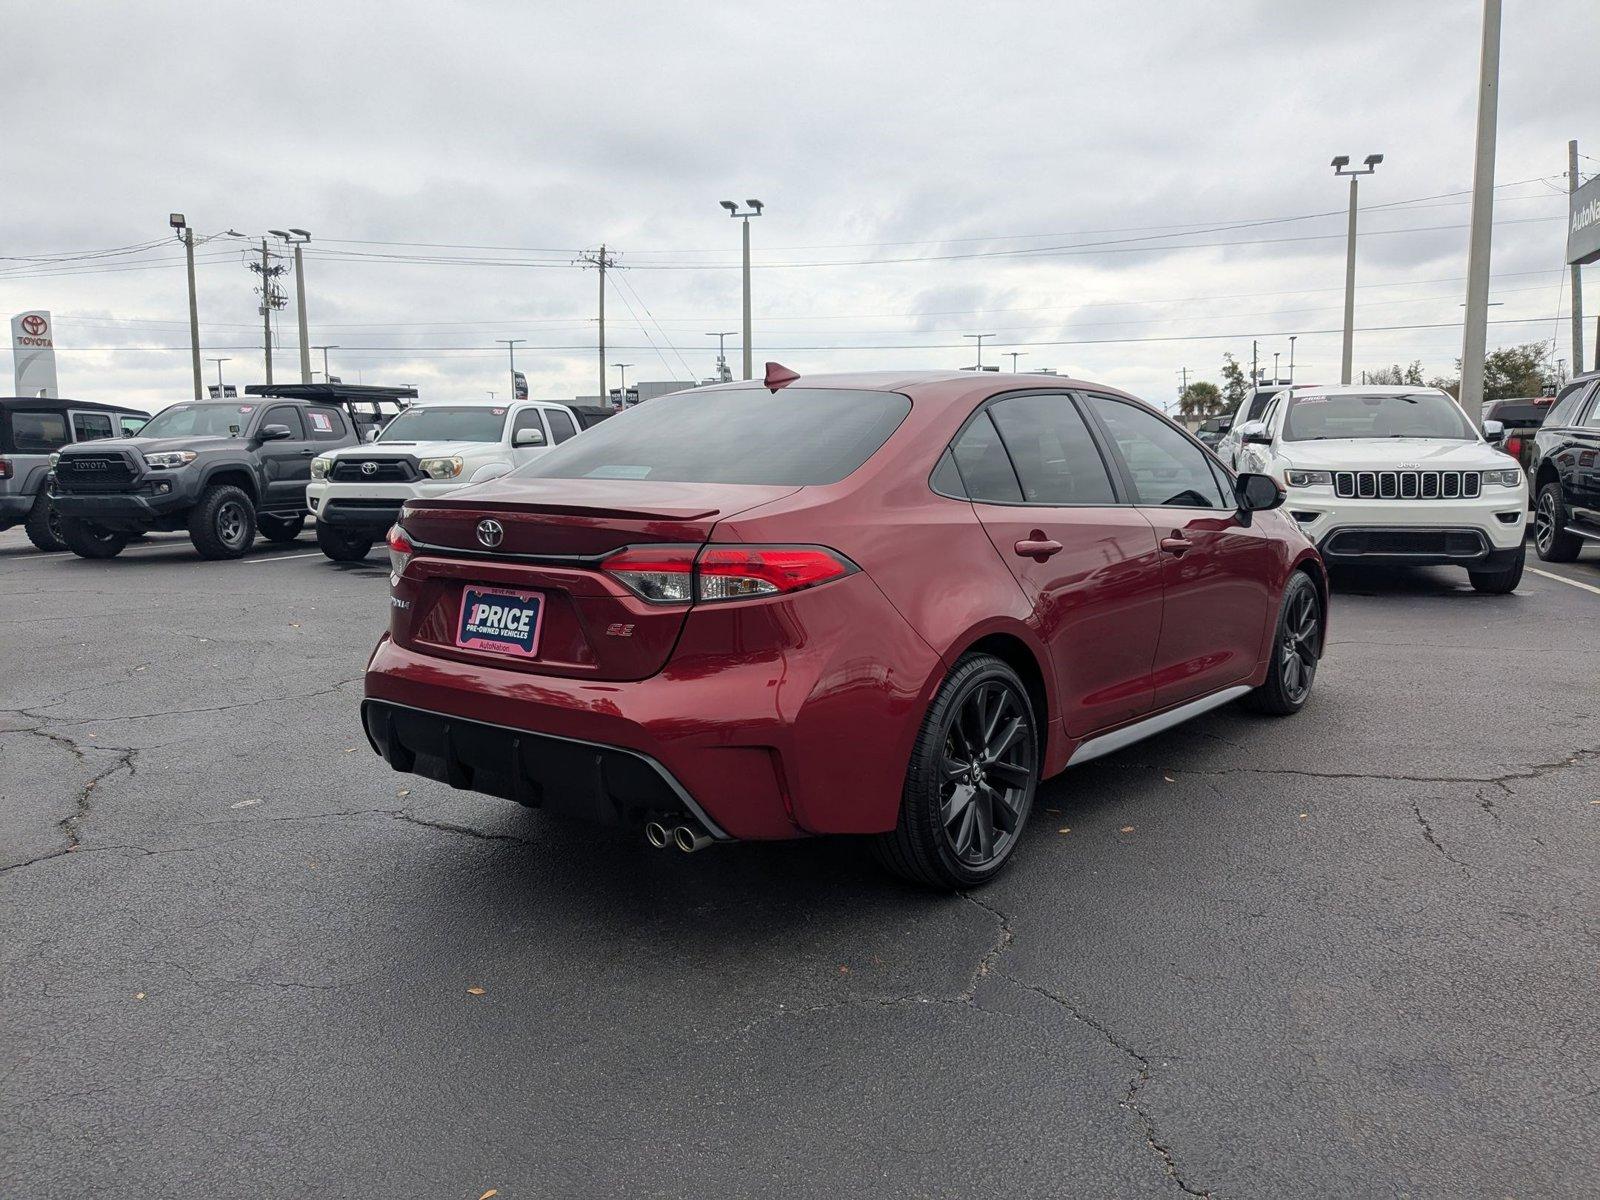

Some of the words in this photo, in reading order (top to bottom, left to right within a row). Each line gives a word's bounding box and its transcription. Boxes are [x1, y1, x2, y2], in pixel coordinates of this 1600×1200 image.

[16, 336, 53, 347] TOYOTA
[1396, 461, 1422, 469] Jeep
[466, 624, 500, 635] PRE-OWNED
[500, 628, 529, 640] VEHICLES
[606, 623, 635, 636] SE
[479, 641, 510, 653] AutoNation
